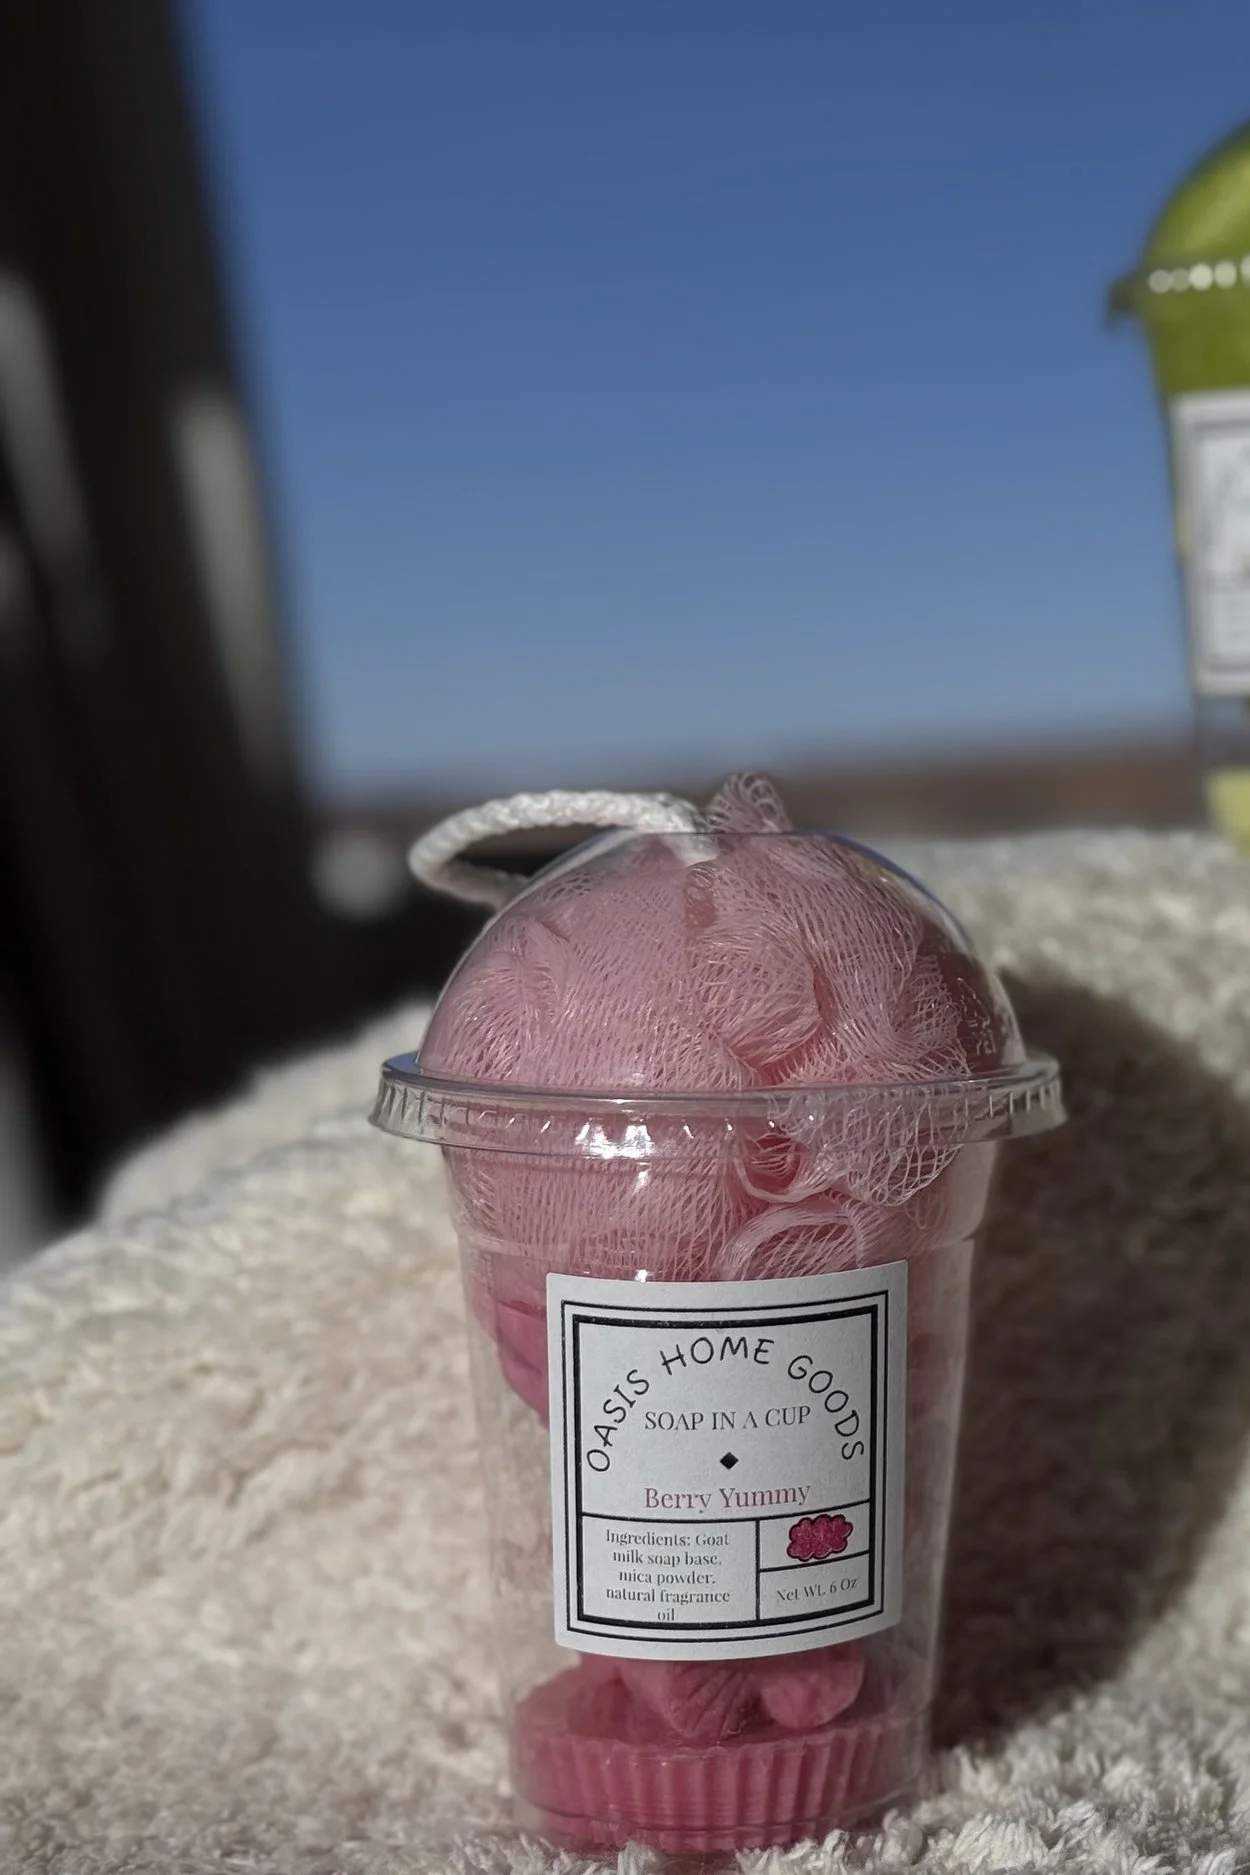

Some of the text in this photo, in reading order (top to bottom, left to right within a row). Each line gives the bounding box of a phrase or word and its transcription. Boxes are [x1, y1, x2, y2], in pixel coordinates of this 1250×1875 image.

[587, 1336, 865, 1472] OASIS HOME GOODS
[644, 1405, 812, 1431] SOAP IN A CUP
[644, 1485, 812, 1514] Berry Yummy
[606, 1529, 730, 1547] Ingredients: Goat
[613, 1549, 644, 1565] milk
[647, 1554, 681, 1568] soap
[618, 1568, 653, 1584] mica
[606, 1588, 731, 1606] natural fragrance
[776, 1588, 799, 1602] Net
[829, 1581, 838, 1594] 6
[840, 1578, 858, 1592] Oz
[657, 1608, 676, 1622] oil
